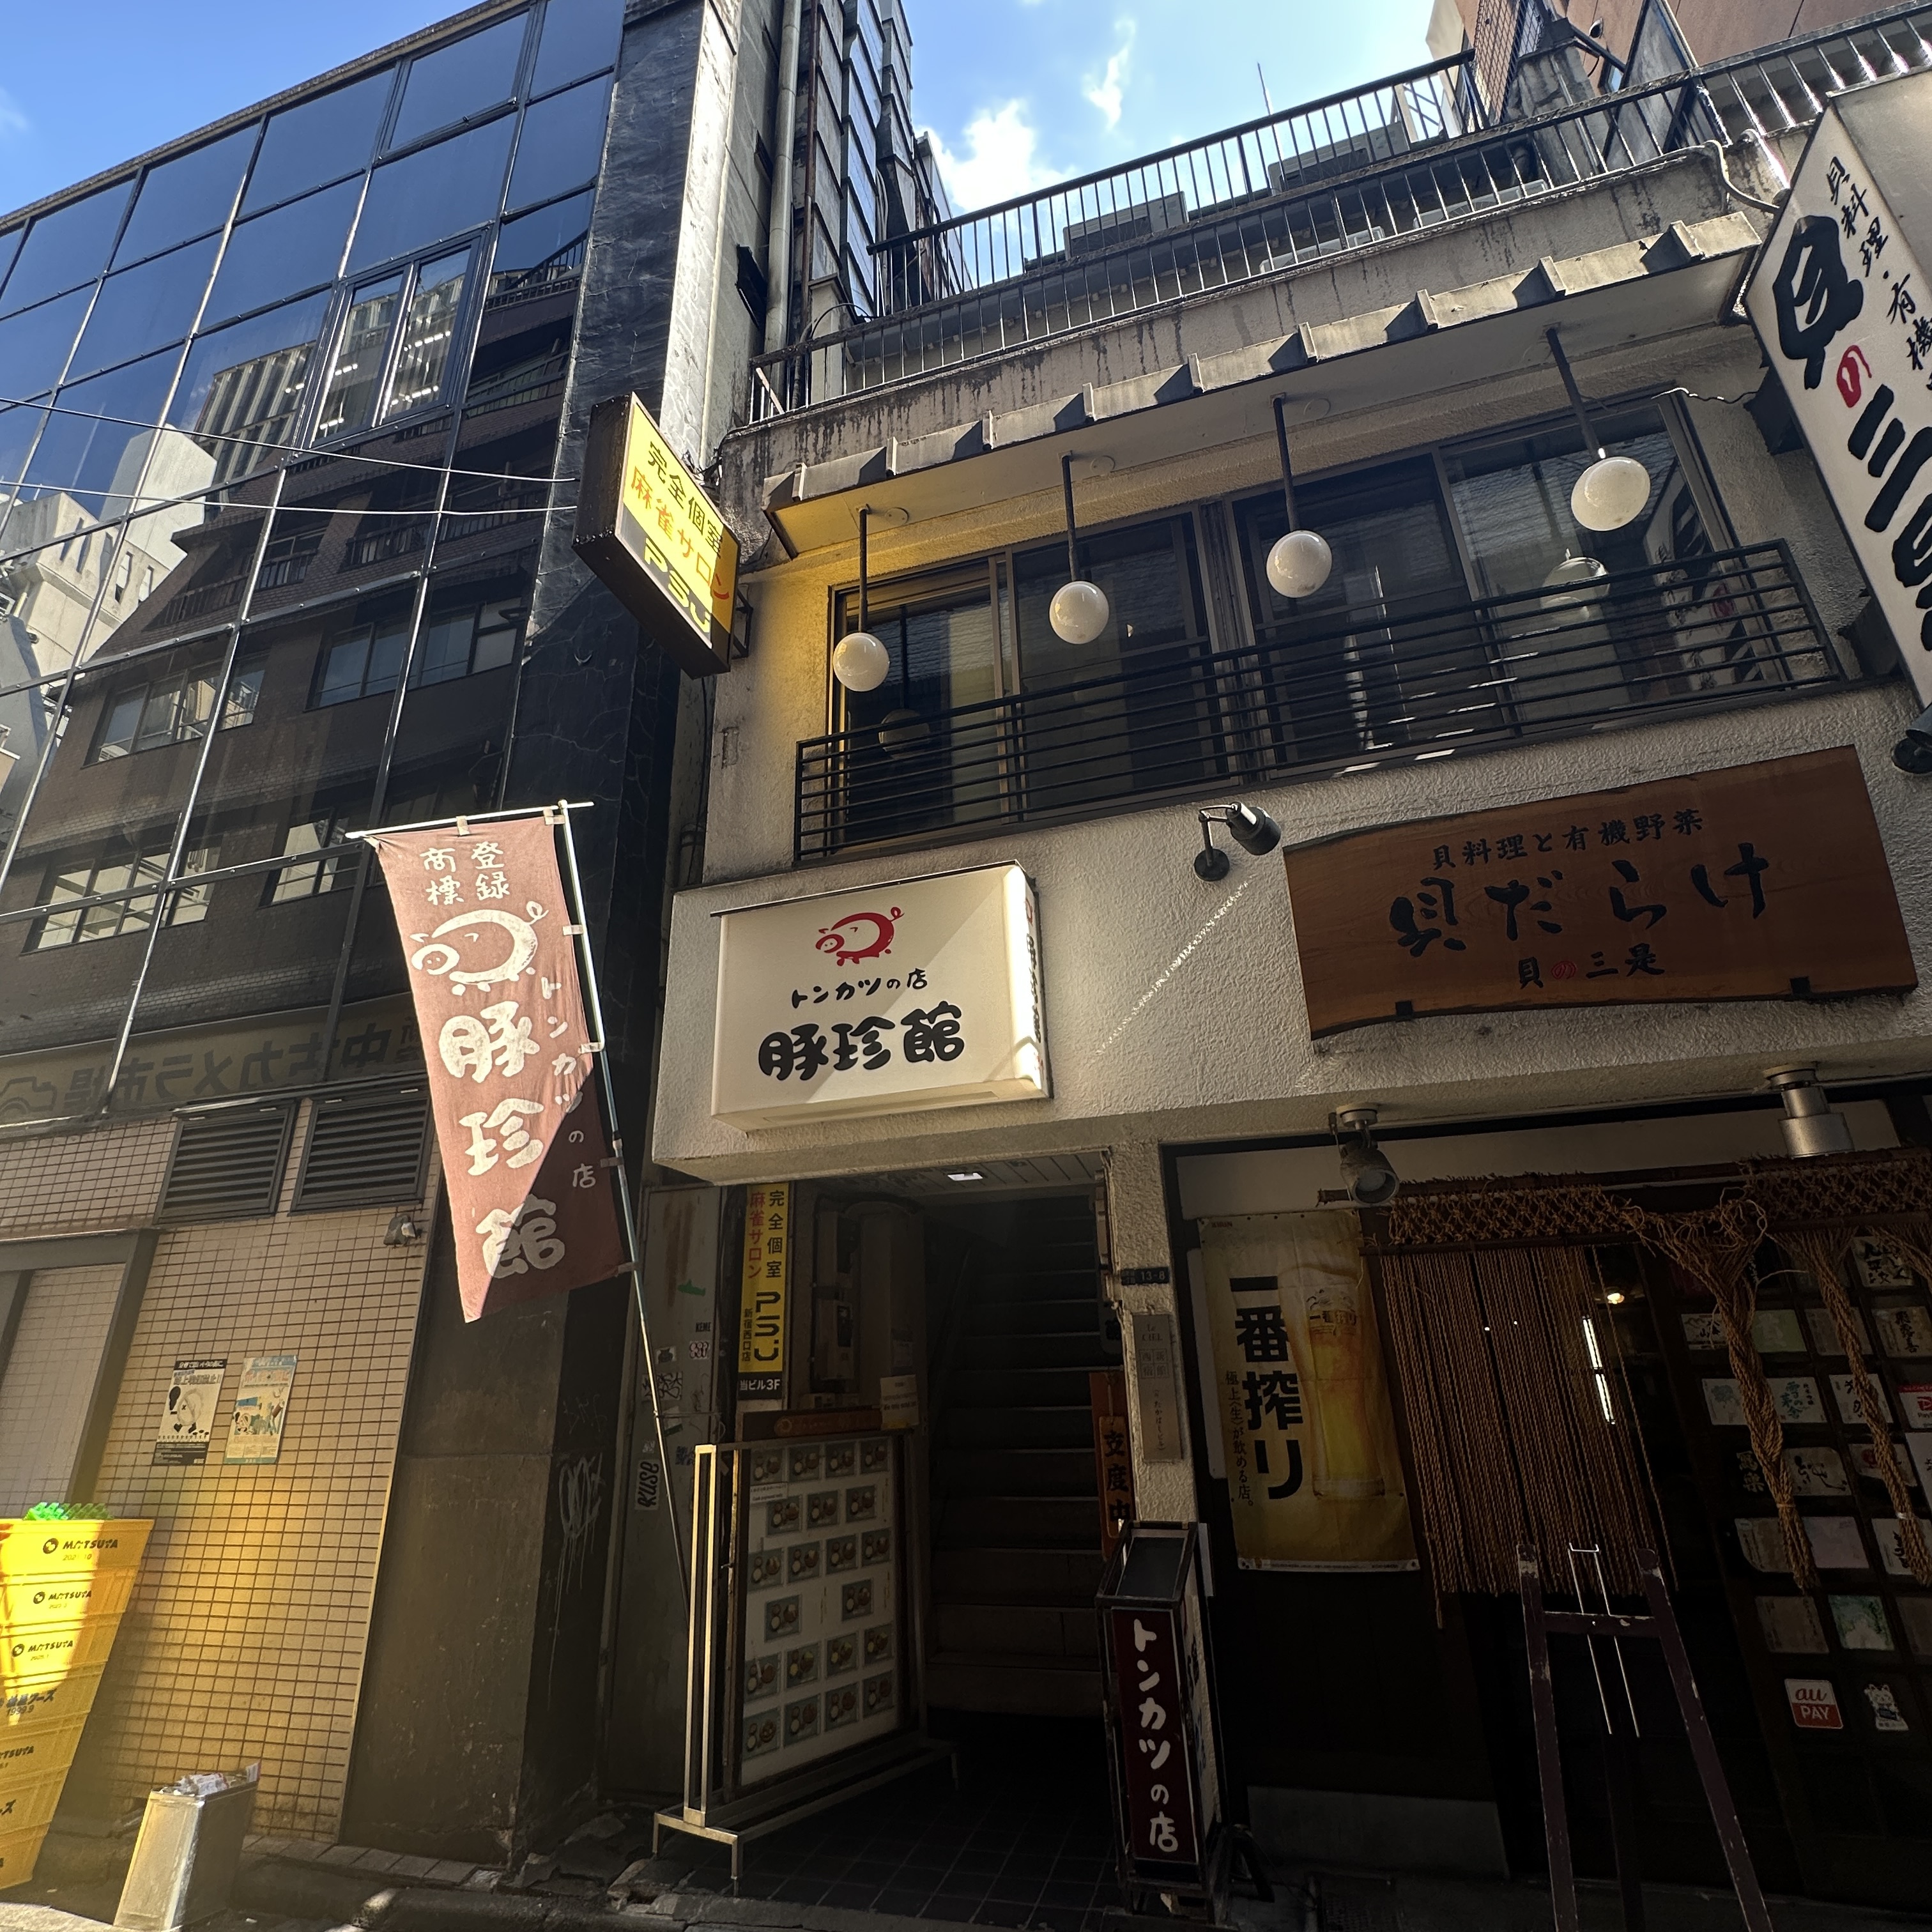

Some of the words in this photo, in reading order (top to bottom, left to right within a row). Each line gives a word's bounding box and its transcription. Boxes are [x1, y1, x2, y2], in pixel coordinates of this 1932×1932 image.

[1826, 156, 1932, 391] 貝料理・有機
[631, 465, 730, 600] 麻雀サロン
[647, 441, 723, 559] 完全個室
[419, 847, 464, 906] 商標
[471, 841, 510, 901] 登録
[1432, 808, 1704, 871] 貝料理と有機野菜
[1388, 841, 1770, 956] 貝だらけ
[791, 967, 928, 1009] トンカツの店
[540, 976, 597, 1189] トンカツの店
[758, 1000, 965, 1081] 豚珍館
[438, 999, 566, 1280] 豚珍館
[747, 1192, 766, 1279] 麻雀サロン
[765, 1190, 785, 1278] 完全個室
[739, 1379, 781, 1391] 当ビル3F
[1229, 1275, 1304, 1500] 一番搾り
[1133, 1618, 1178, 1853] トンカツの店
[1795, 1687, 1827, 1702] au
[1800, 1705, 1830, 1721] PAY
